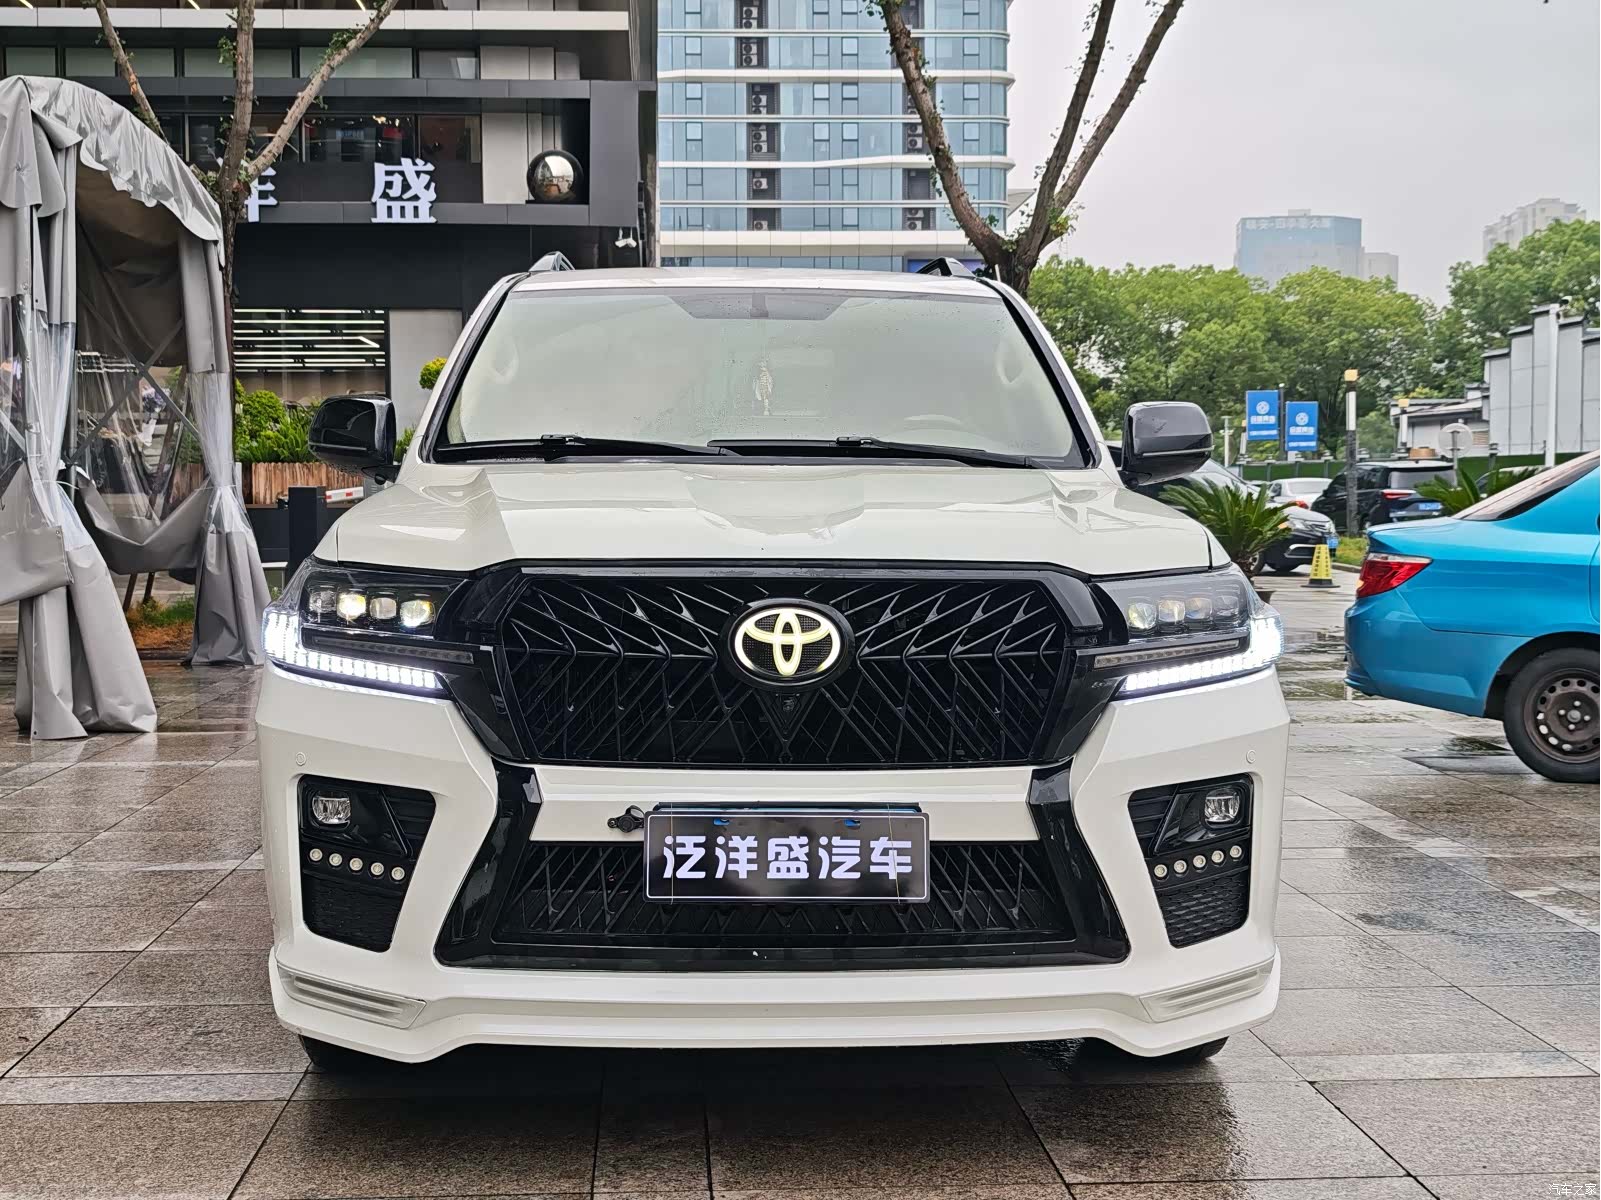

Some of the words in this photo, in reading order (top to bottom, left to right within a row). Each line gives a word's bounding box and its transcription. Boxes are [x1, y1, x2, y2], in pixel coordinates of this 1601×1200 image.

[663, 835, 912, 880] 泛洋盛汽车
